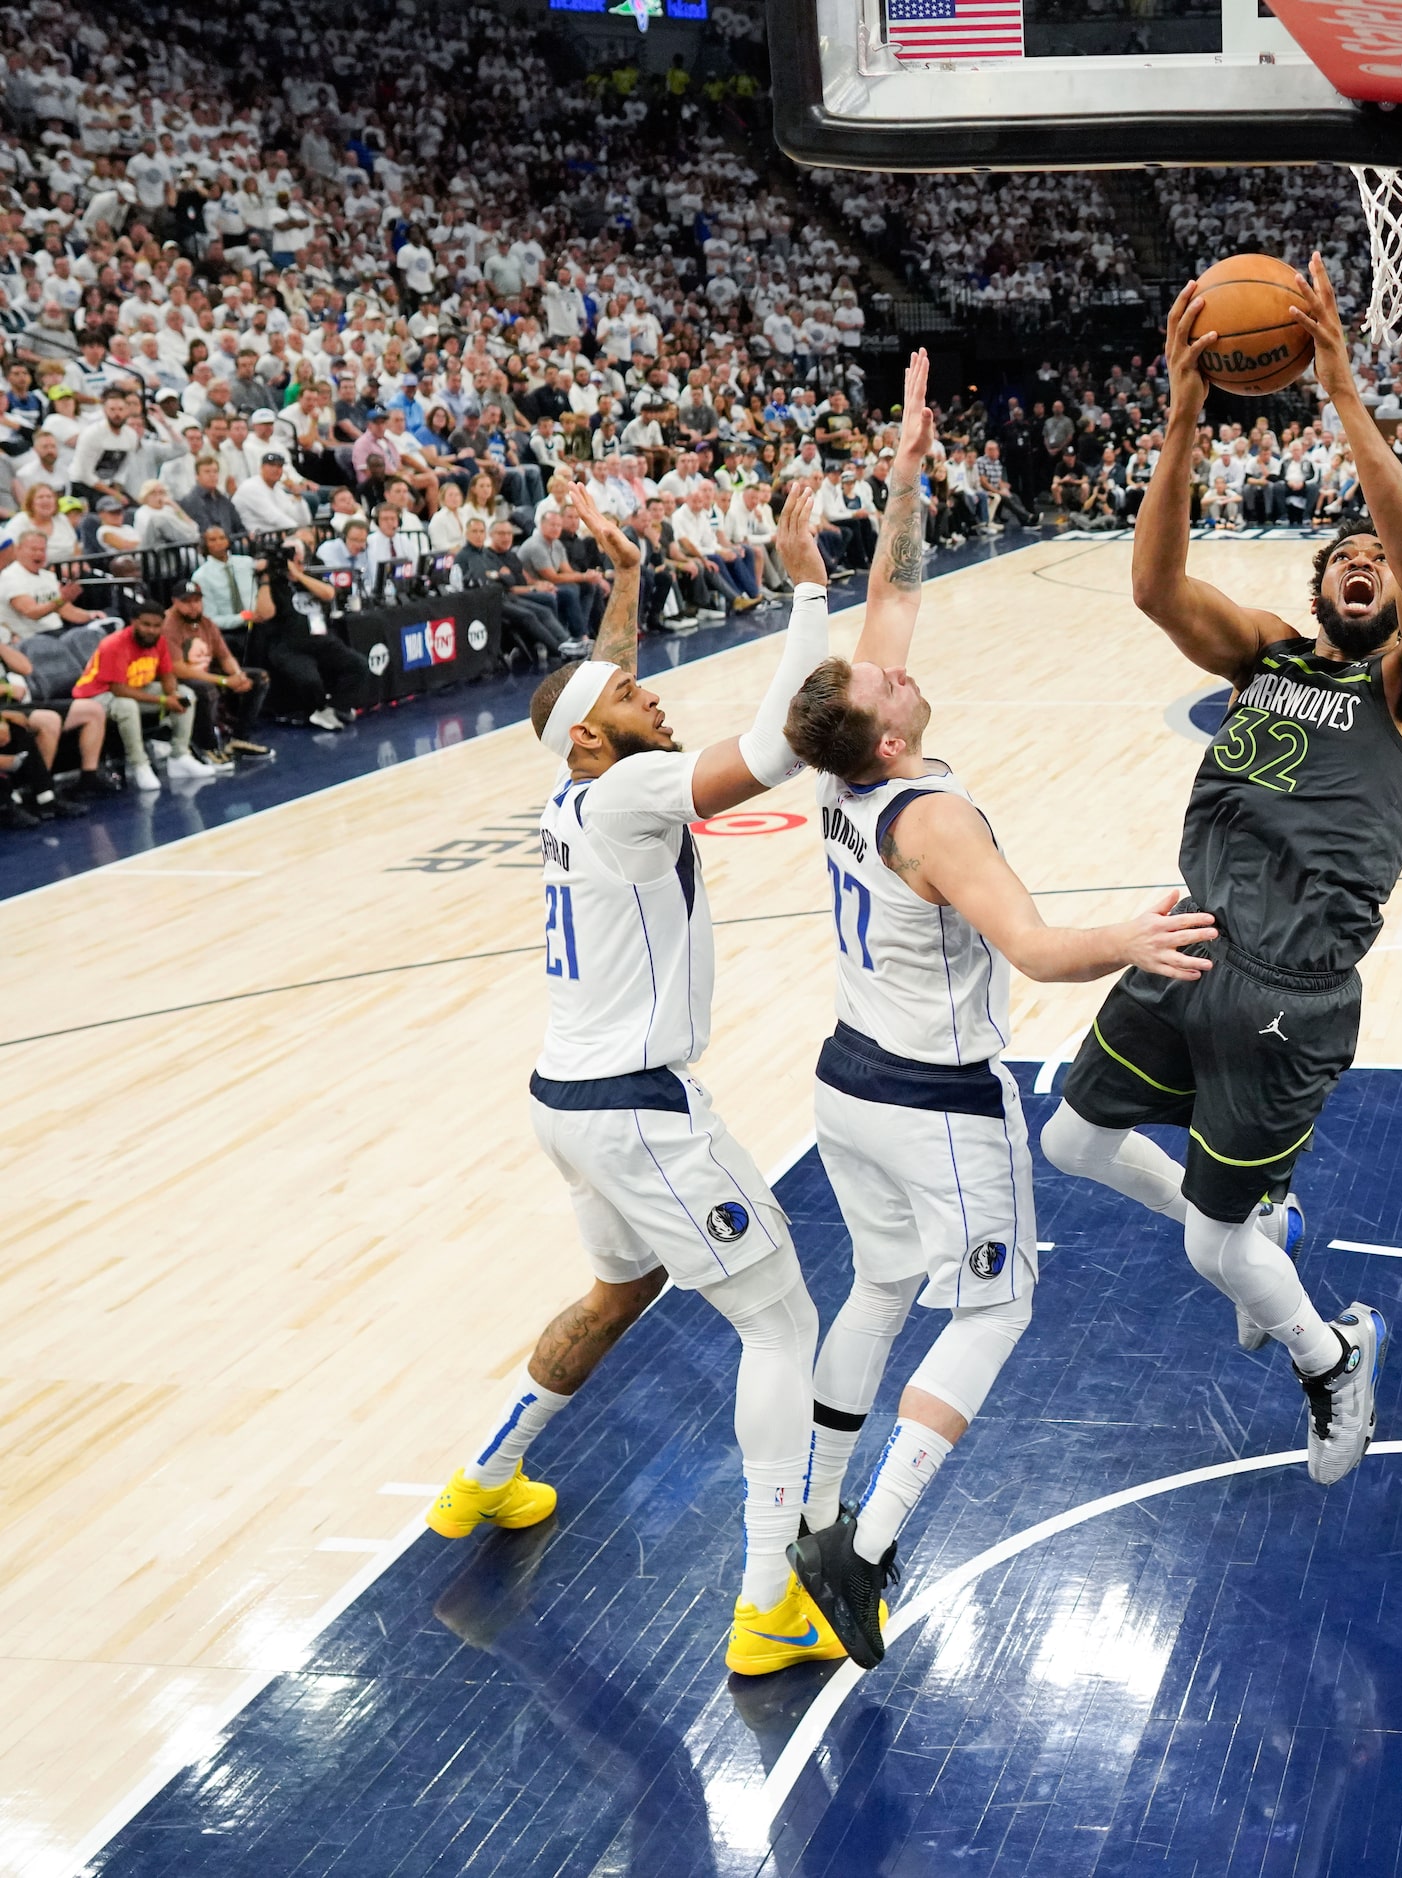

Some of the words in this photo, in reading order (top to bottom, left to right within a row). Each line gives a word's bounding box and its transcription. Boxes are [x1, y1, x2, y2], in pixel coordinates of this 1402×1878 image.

[1200, 345, 1289, 373] Wilson
[1214, 706, 1309, 793] 32
[545, 884, 580, 980] 21
[827, 853, 875, 972] 77
